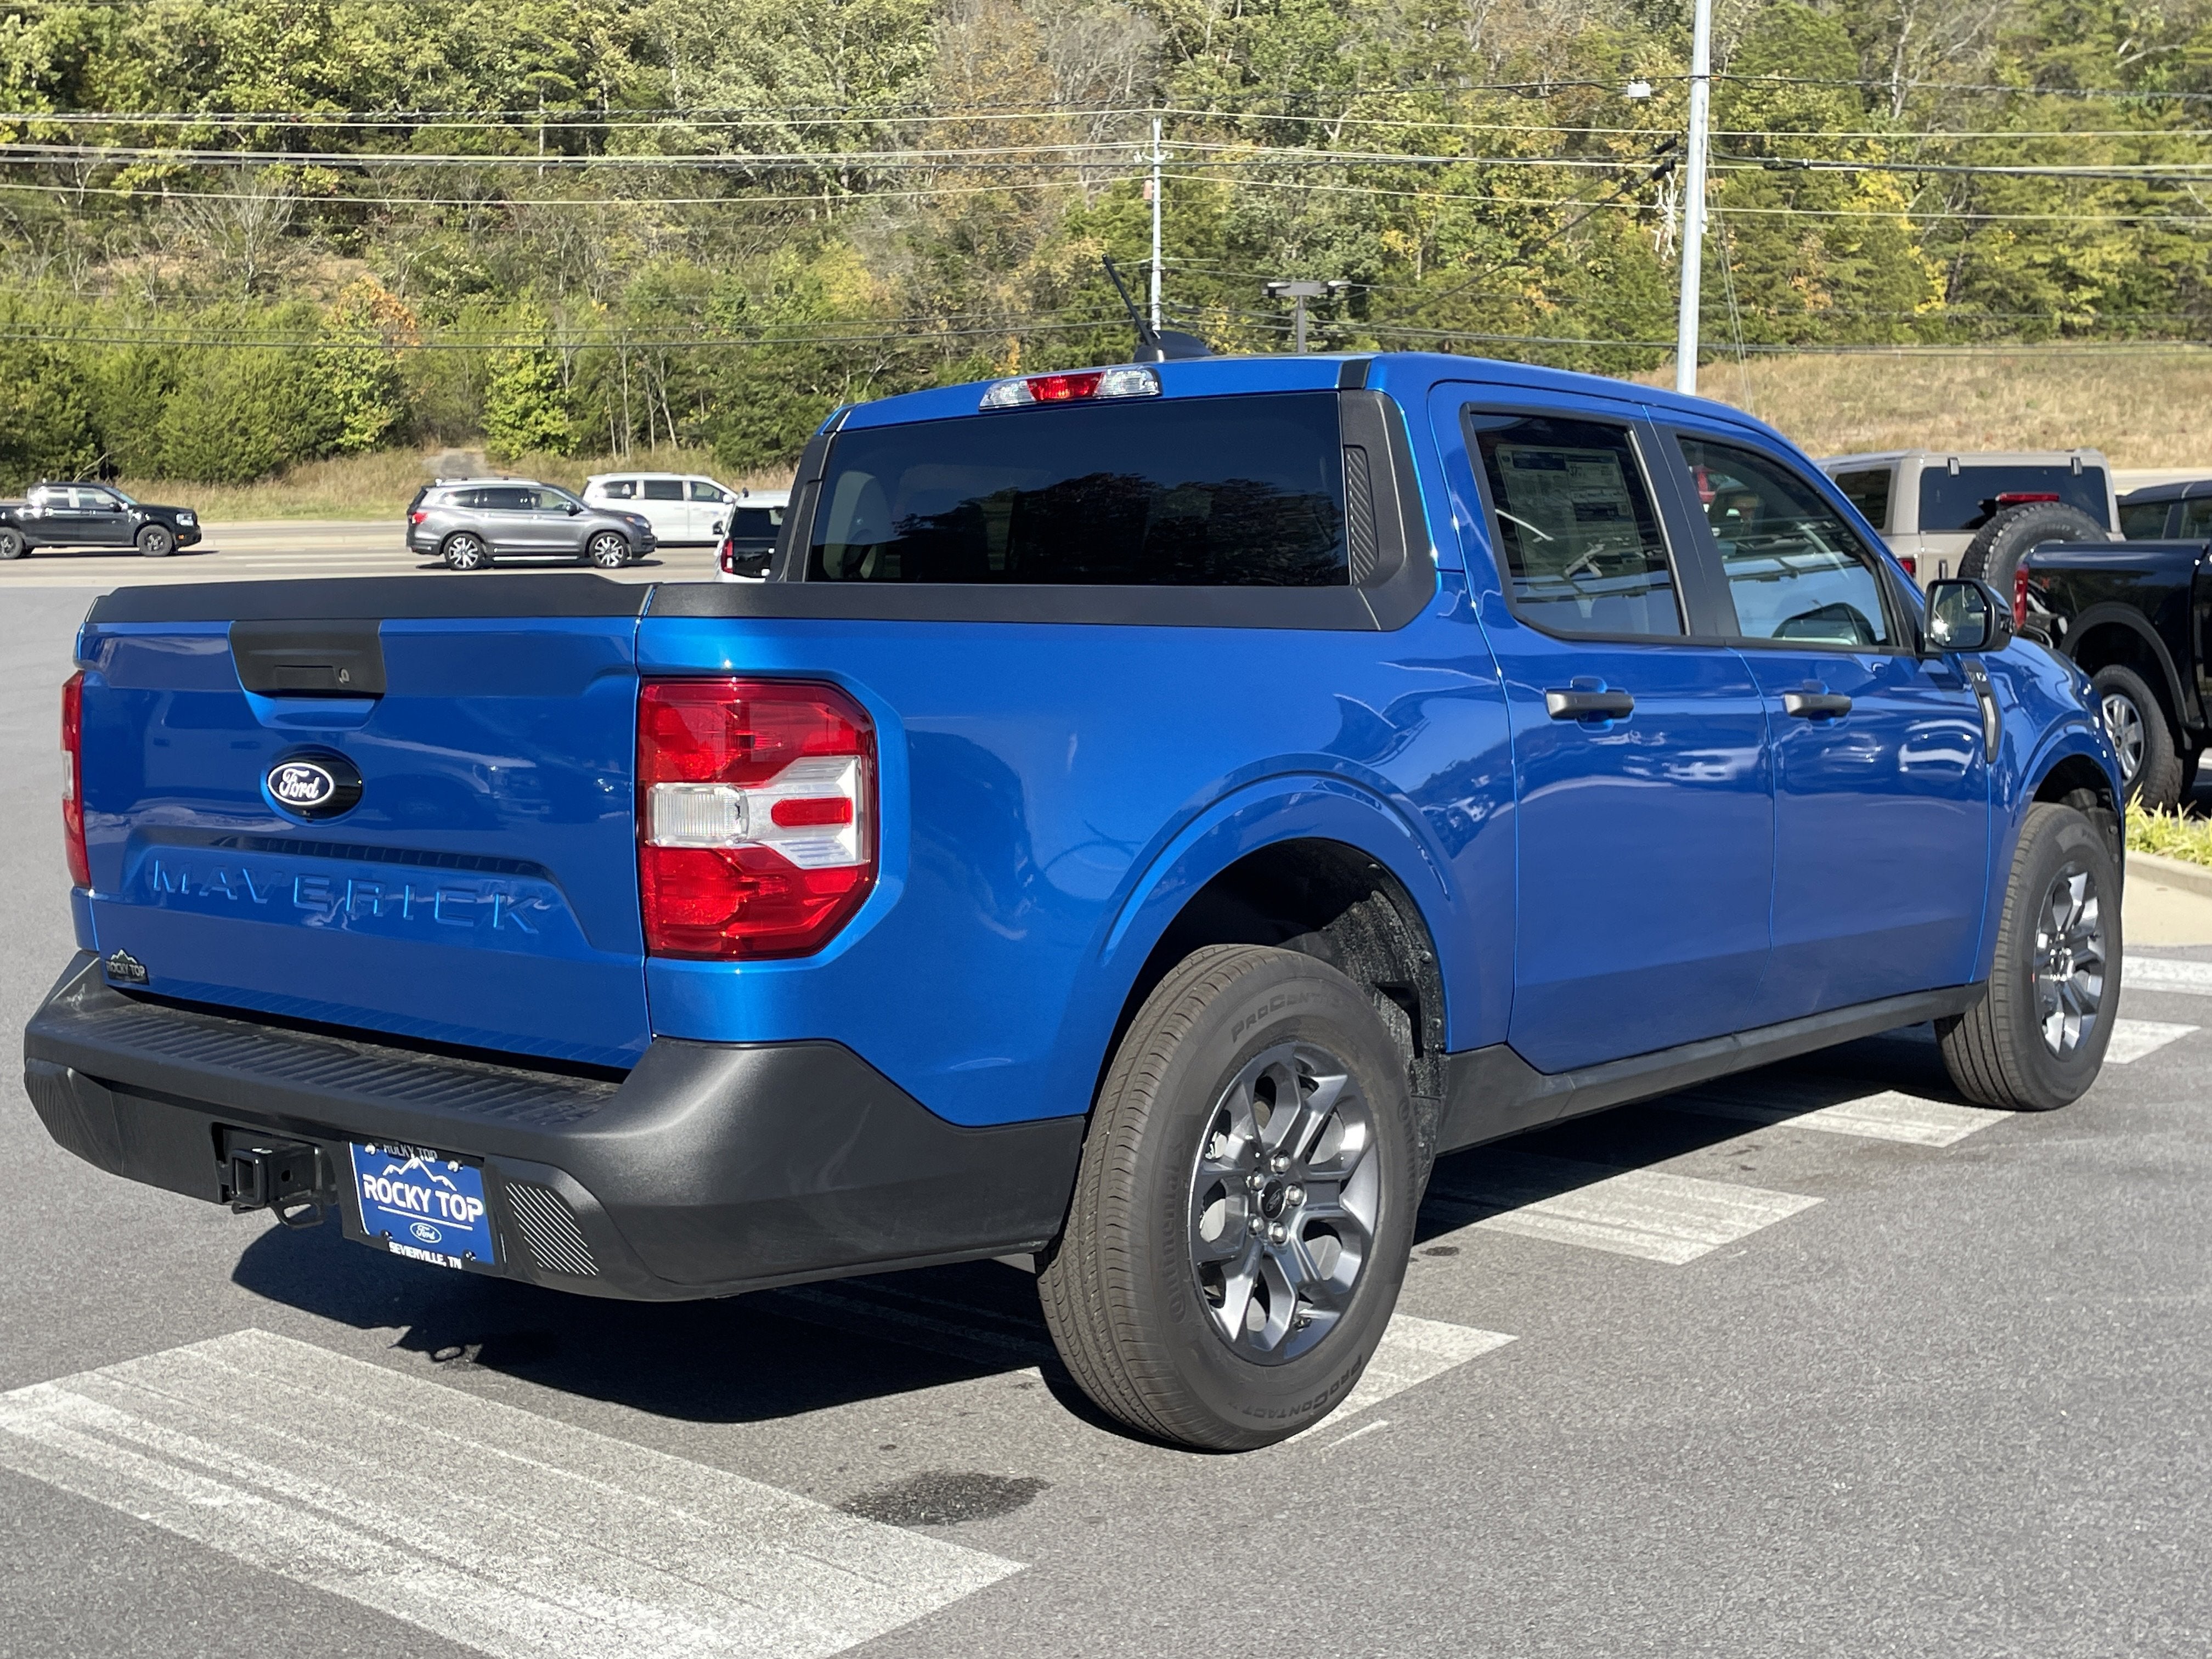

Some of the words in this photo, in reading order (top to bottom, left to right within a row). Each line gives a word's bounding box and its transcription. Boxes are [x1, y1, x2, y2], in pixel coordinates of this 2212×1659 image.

[279, 768, 320, 799] Ford
[151, 858, 539, 934] MAVERICK
[106, 961, 129, 975] ROCKY
[129, 964, 145, 977] TOP
[362, 1173, 431, 1213] ROCKY
[435, 1190, 483, 1223] TOP
[416, 1224, 436, 1240] Ford
[448, 1256, 462, 1269] TN
